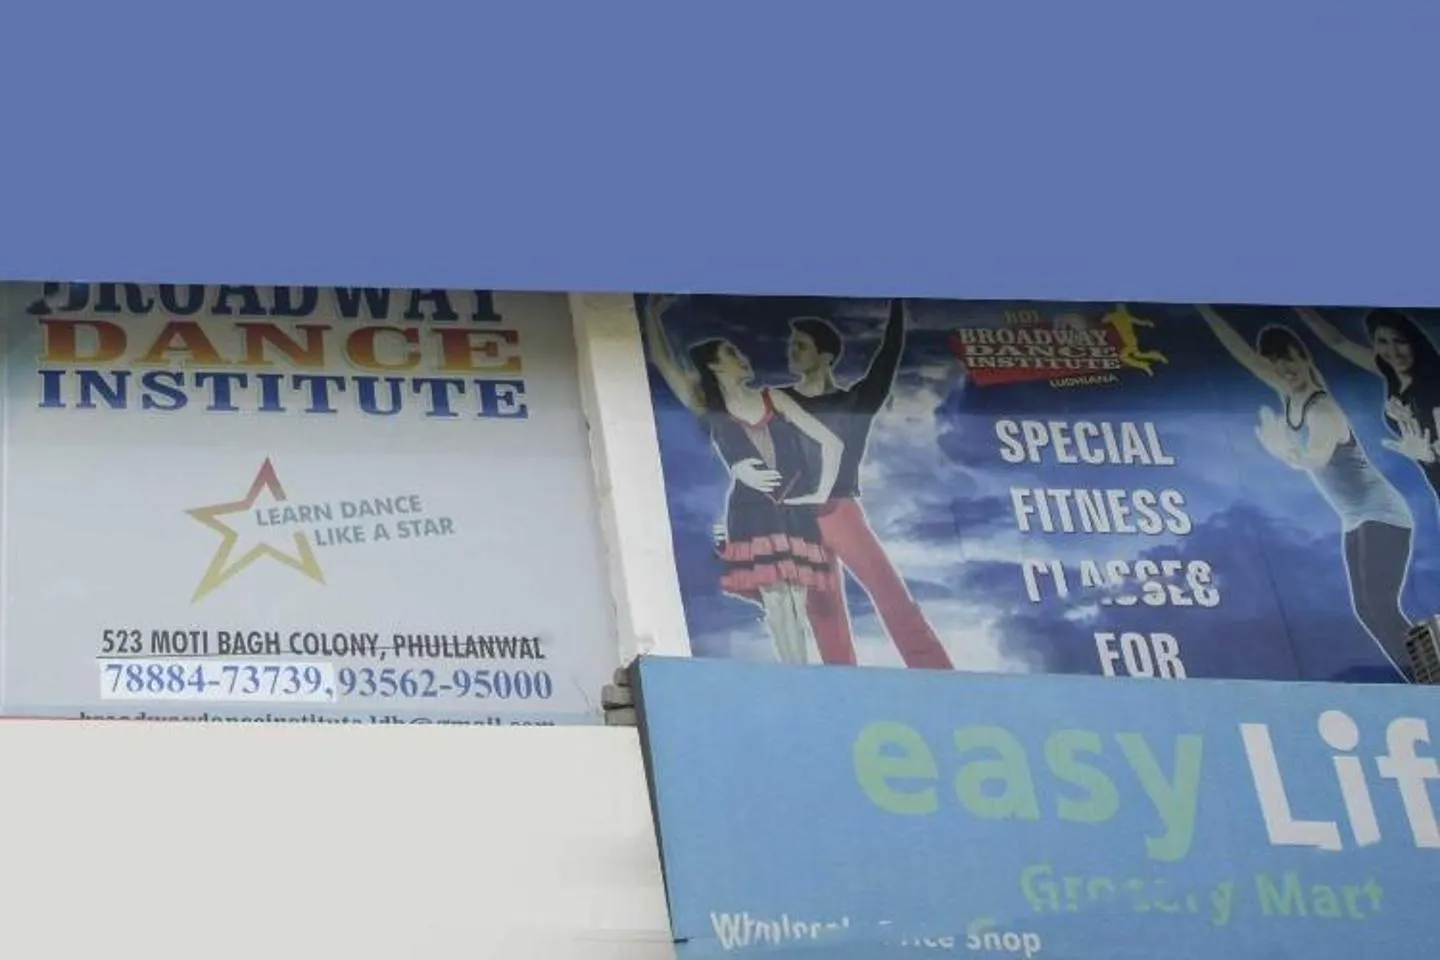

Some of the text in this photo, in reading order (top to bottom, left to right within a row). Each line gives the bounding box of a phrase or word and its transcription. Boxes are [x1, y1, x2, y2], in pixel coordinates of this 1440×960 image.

[38, 318, 523, 372] DANCE
[959, 328, 1108, 347] BROADWAY
[965, 344, 1119, 359] DANCE
[965, 356, 1121, 371] INSTITUTE
[37, 369, 530, 419] INSTITUTE
[995, 419, 1175, 466] SPECIAL
[256, 494, 423, 527] LEARN DANCE
[314, 517, 456, 546] LIKE A STAR
[1010, 486, 1192, 535] FITNESS
[102, 629, 546, 660] 523 MOTI BAGH COLONY, PHULLANWAL
[1094, 632, 1187, 680] FOR
[853, 720, 1203, 862] easy
[1254, 869, 1384, 920] Mart
